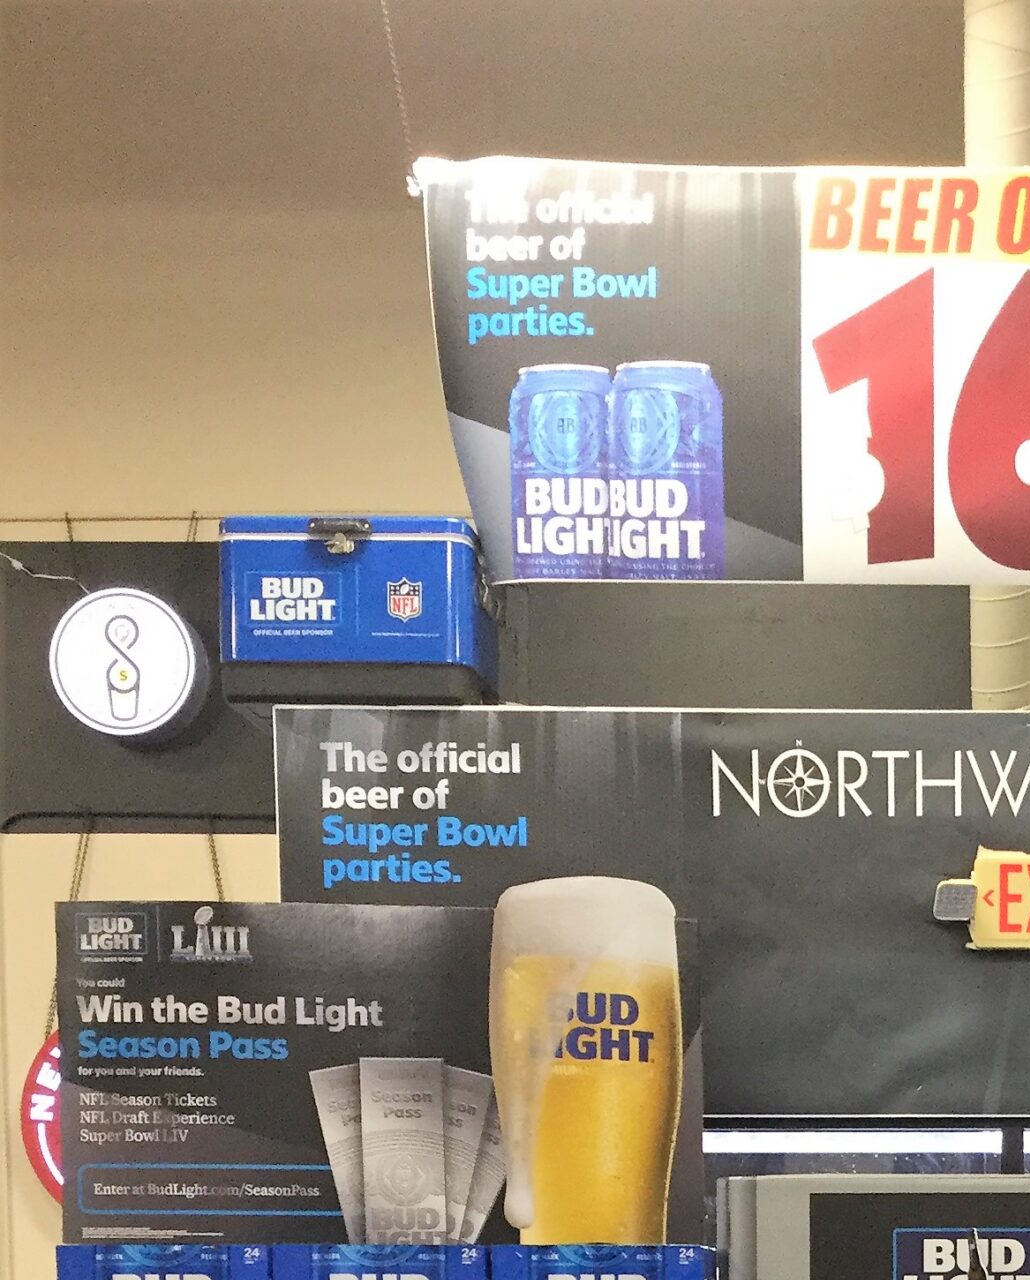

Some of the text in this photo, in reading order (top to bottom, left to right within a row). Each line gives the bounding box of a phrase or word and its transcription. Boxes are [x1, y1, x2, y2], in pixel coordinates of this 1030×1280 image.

[809, 177, 979, 254] BEER
[466, 227, 586, 262] beer of
[467, 265, 658, 305] Super Bowl
[469, 304, 594, 344] parties.
[262, 578, 323, 598] BUD
[250, 599, 336, 621] LIGHT
[392, 598, 418, 613] NFL
[320, 742, 520, 773] The official
[322, 778, 449, 809] beer of
[322, 816, 527, 852] Super Bowl
[324, 852, 461, 888] parties.
[88, 917, 134, 933] BUD
[80, 934, 143, 950] LIGHT
[76, 995, 382, 1032] Win the Bud Light
[78, 1030, 288, 1059] Season Pass
[77, 1067, 205, 1079] for you and your friends.
[111, 1093, 161, 1106] Season
[164, 1093, 217, 1107] Tickets
[112, 1111, 150, 1124] Draft
[80, 1129, 121, 1145] Super
[124, 1129, 160, 1142] Bowl
[94, 1183, 130, 1196] Enter
[132, 1184, 144, 1196] at
